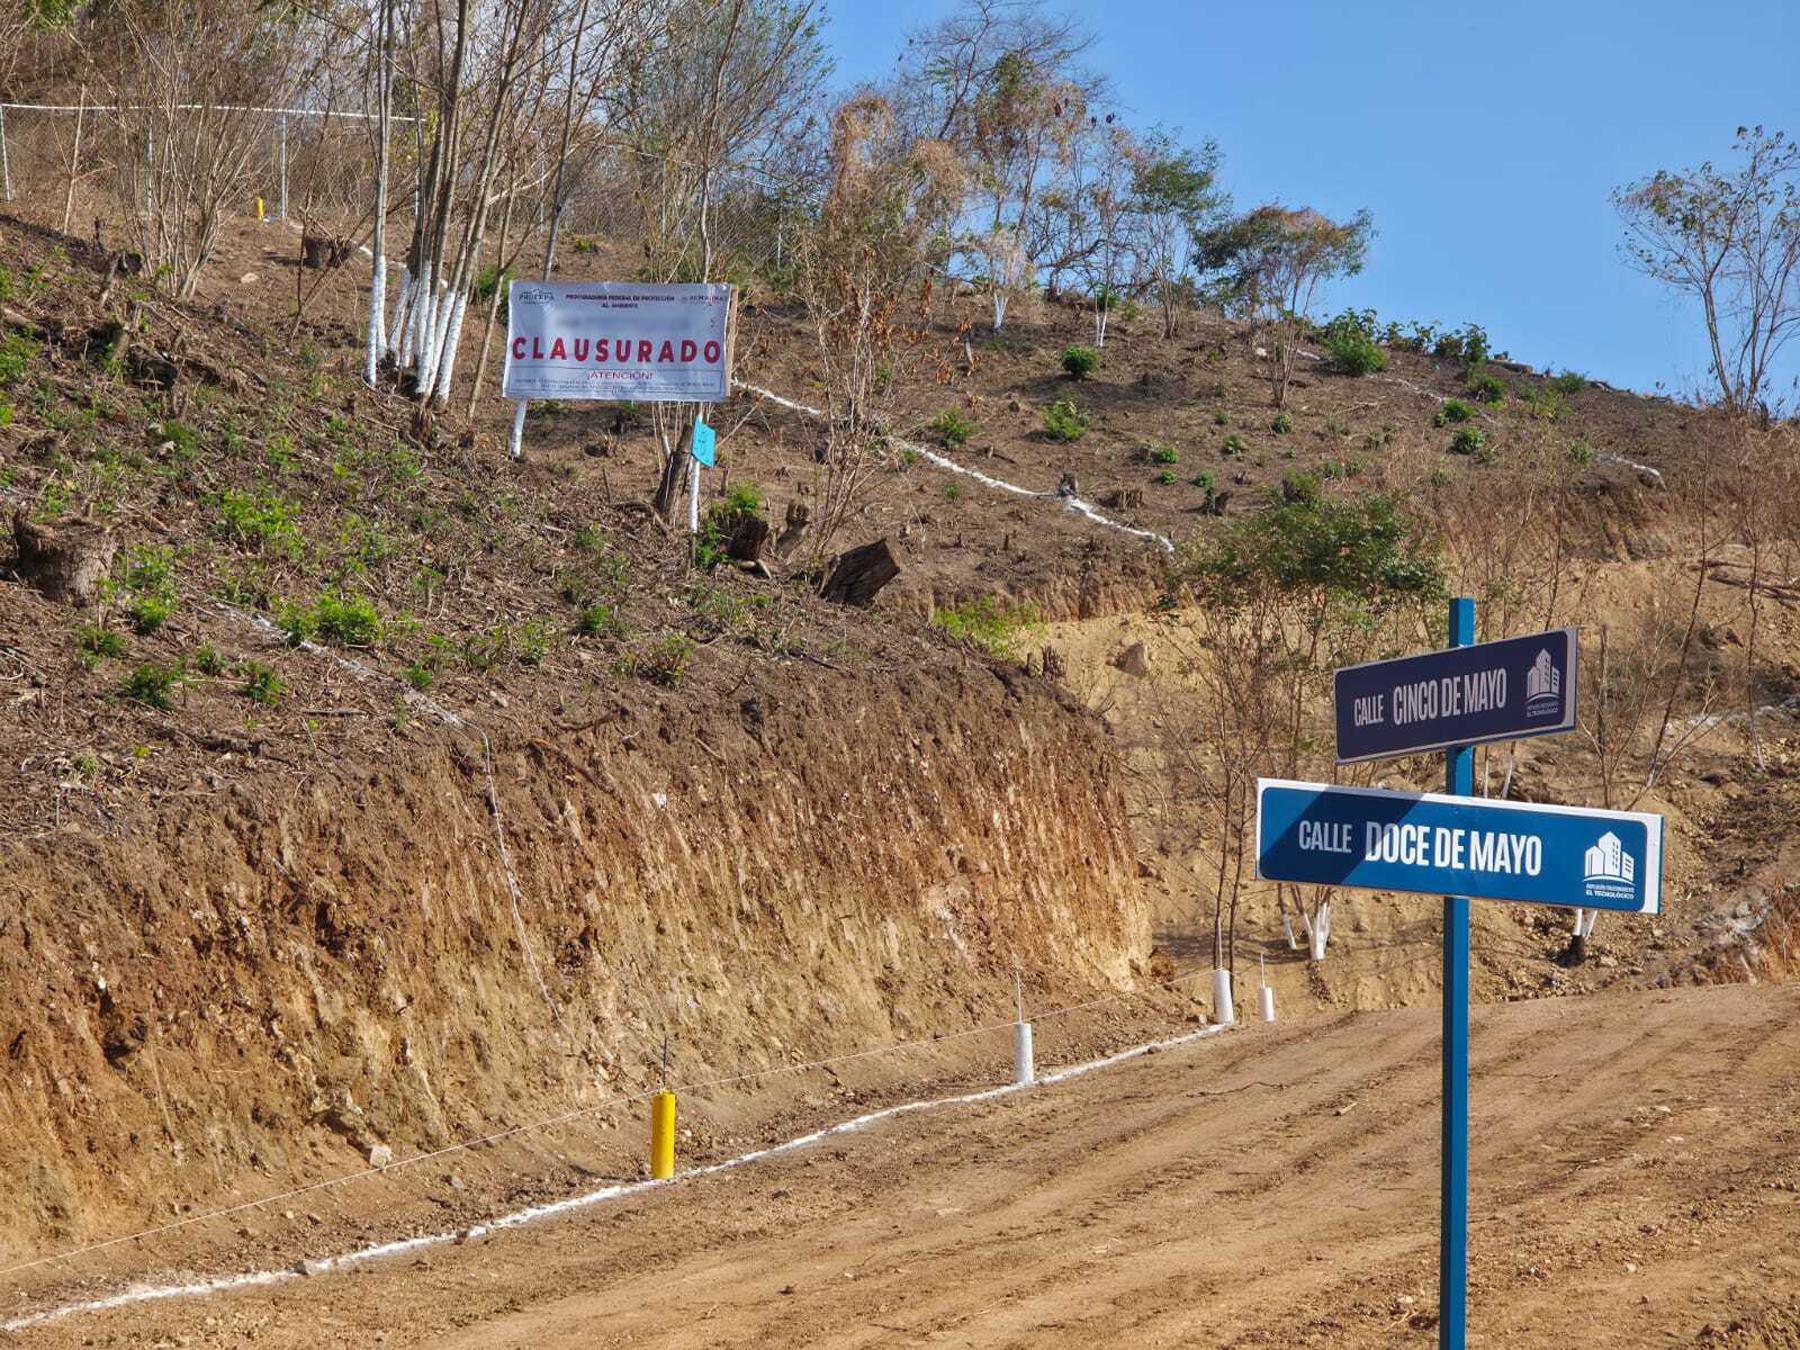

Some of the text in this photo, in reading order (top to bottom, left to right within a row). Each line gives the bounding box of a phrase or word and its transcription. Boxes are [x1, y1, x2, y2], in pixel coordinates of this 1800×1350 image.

[512, 337, 720, 363] CLAUSURADO
[1354, 668, 1507, 726] CALLE CINCO DE MAYO
[1299, 820, 1542, 876] CALLE DOCE DE MAYO
